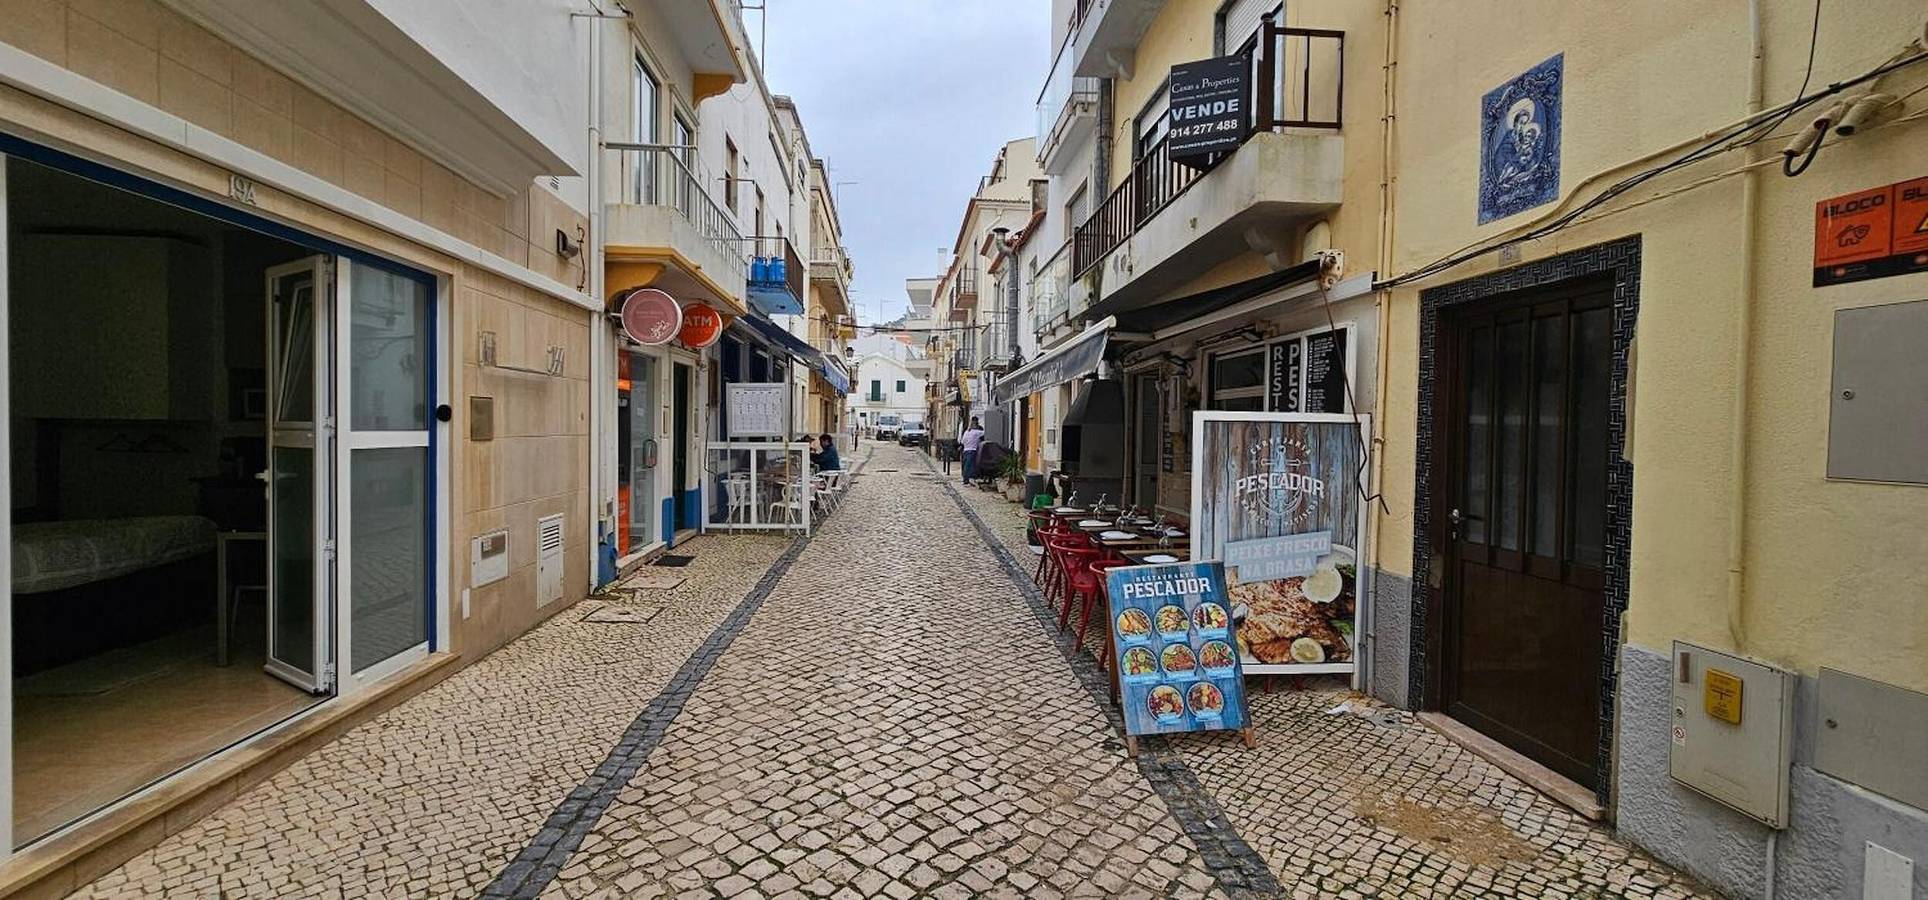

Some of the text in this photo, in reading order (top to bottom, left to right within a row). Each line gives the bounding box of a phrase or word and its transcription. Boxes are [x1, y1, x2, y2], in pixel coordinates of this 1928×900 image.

[1201, 77, 1240, 89] Properties
[1171, 98, 1240, 121] VENDE
[1170, 119, 1238, 139] 914 277 488
[1823, 194, 1886, 218] BLOCO
[683, 314, 712, 327] ATM
[1272, 345, 1284, 412] REST
[1288, 343, 1300, 412] PES
[1235, 472, 1325, 500] PESCADOR
[1228, 537, 1328, 561] PEIXE FRESCO
[1265, 557, 1314, 577] BRASA
[1122, 577, 1212, 599] PESCADOR
